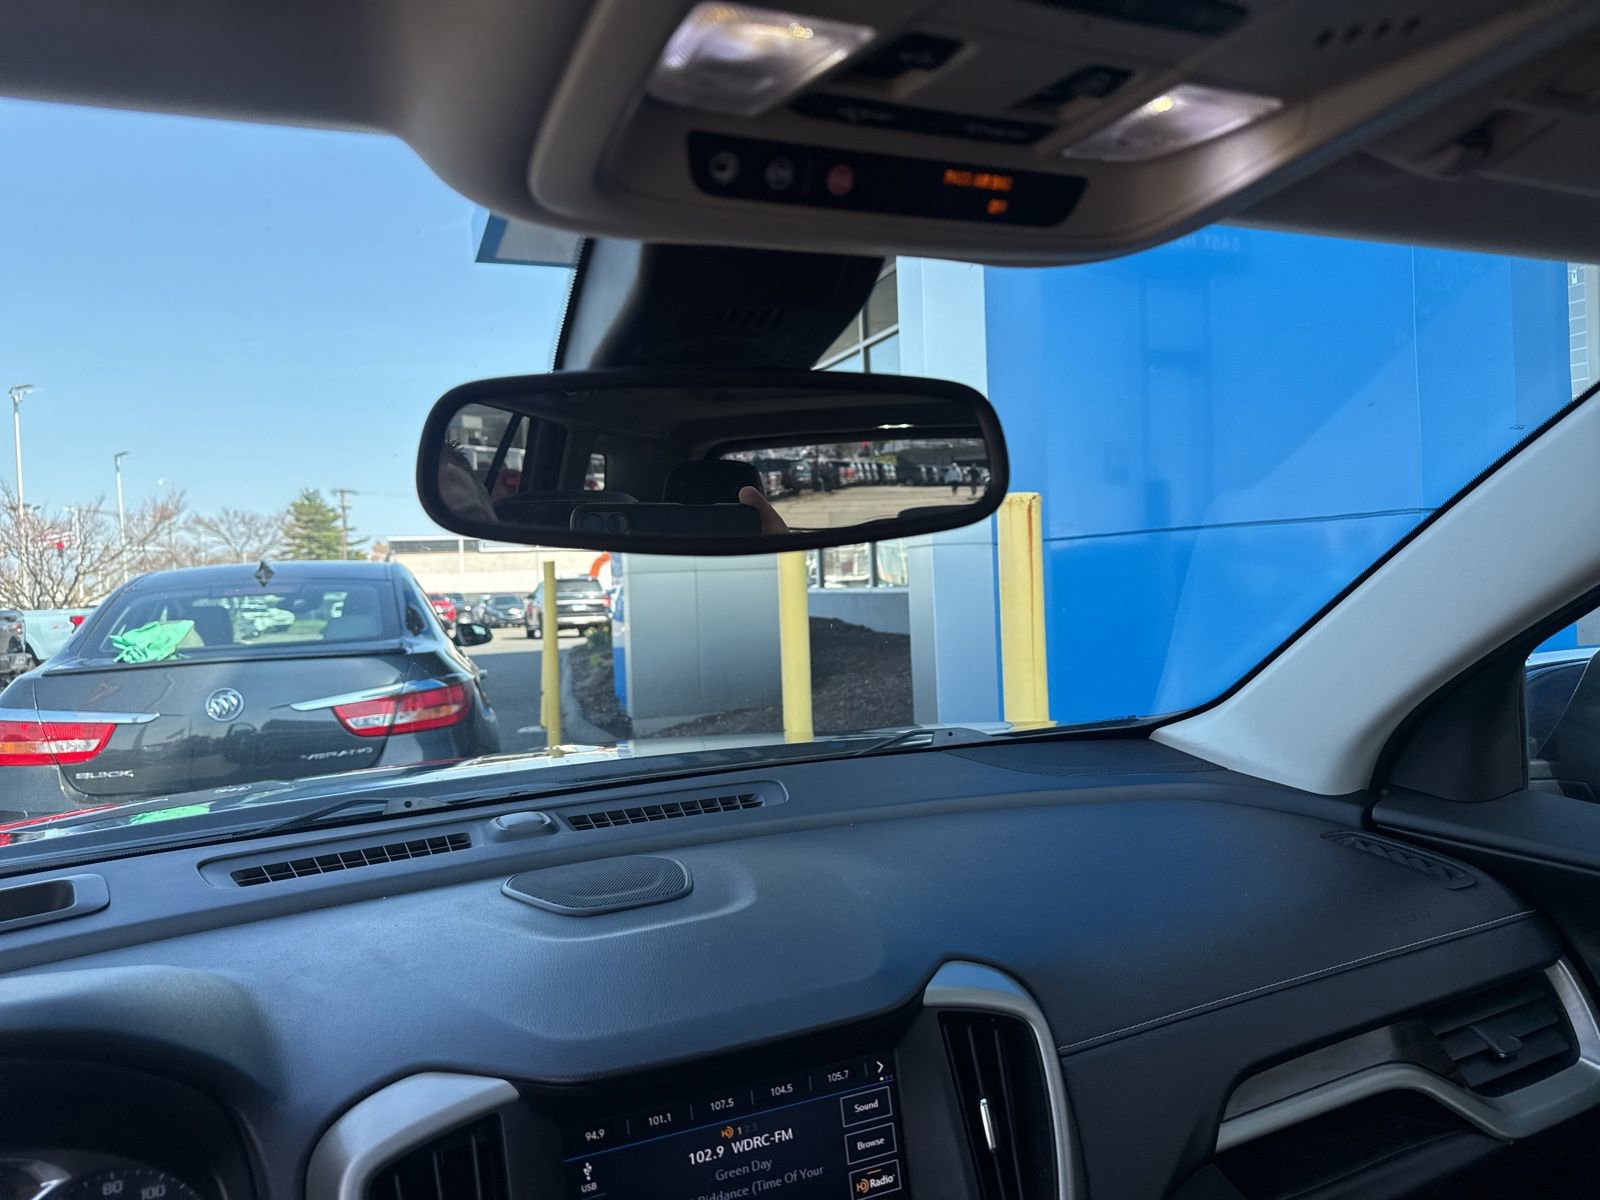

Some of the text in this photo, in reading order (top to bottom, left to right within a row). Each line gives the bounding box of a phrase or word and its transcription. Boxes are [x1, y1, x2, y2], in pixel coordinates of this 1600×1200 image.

[75, 769, 134, 780] BUICK
[585, 1069, 849, 1141] 94.9 101.1 107.5 104.5 105.7
[854, 1098, 879, 1113] Sound
[737, 1126, 742, 1136] 1
[688, 1127, 793, 1165] 102.9 WDRC-FM
[857, 1137, 885, 1151] Browse
[715, 1159, 772, 1181] Green Day
[581, 1182, 598, 1193] USB
[752, 1178, 783, 1196] (Time
[784, 1171, 799, 1185] Of
[799, 1166, 824, 1181] Your
[870, 1174, 895, 1188] Radio
[102, 1180, 166, 1200] 80 100
